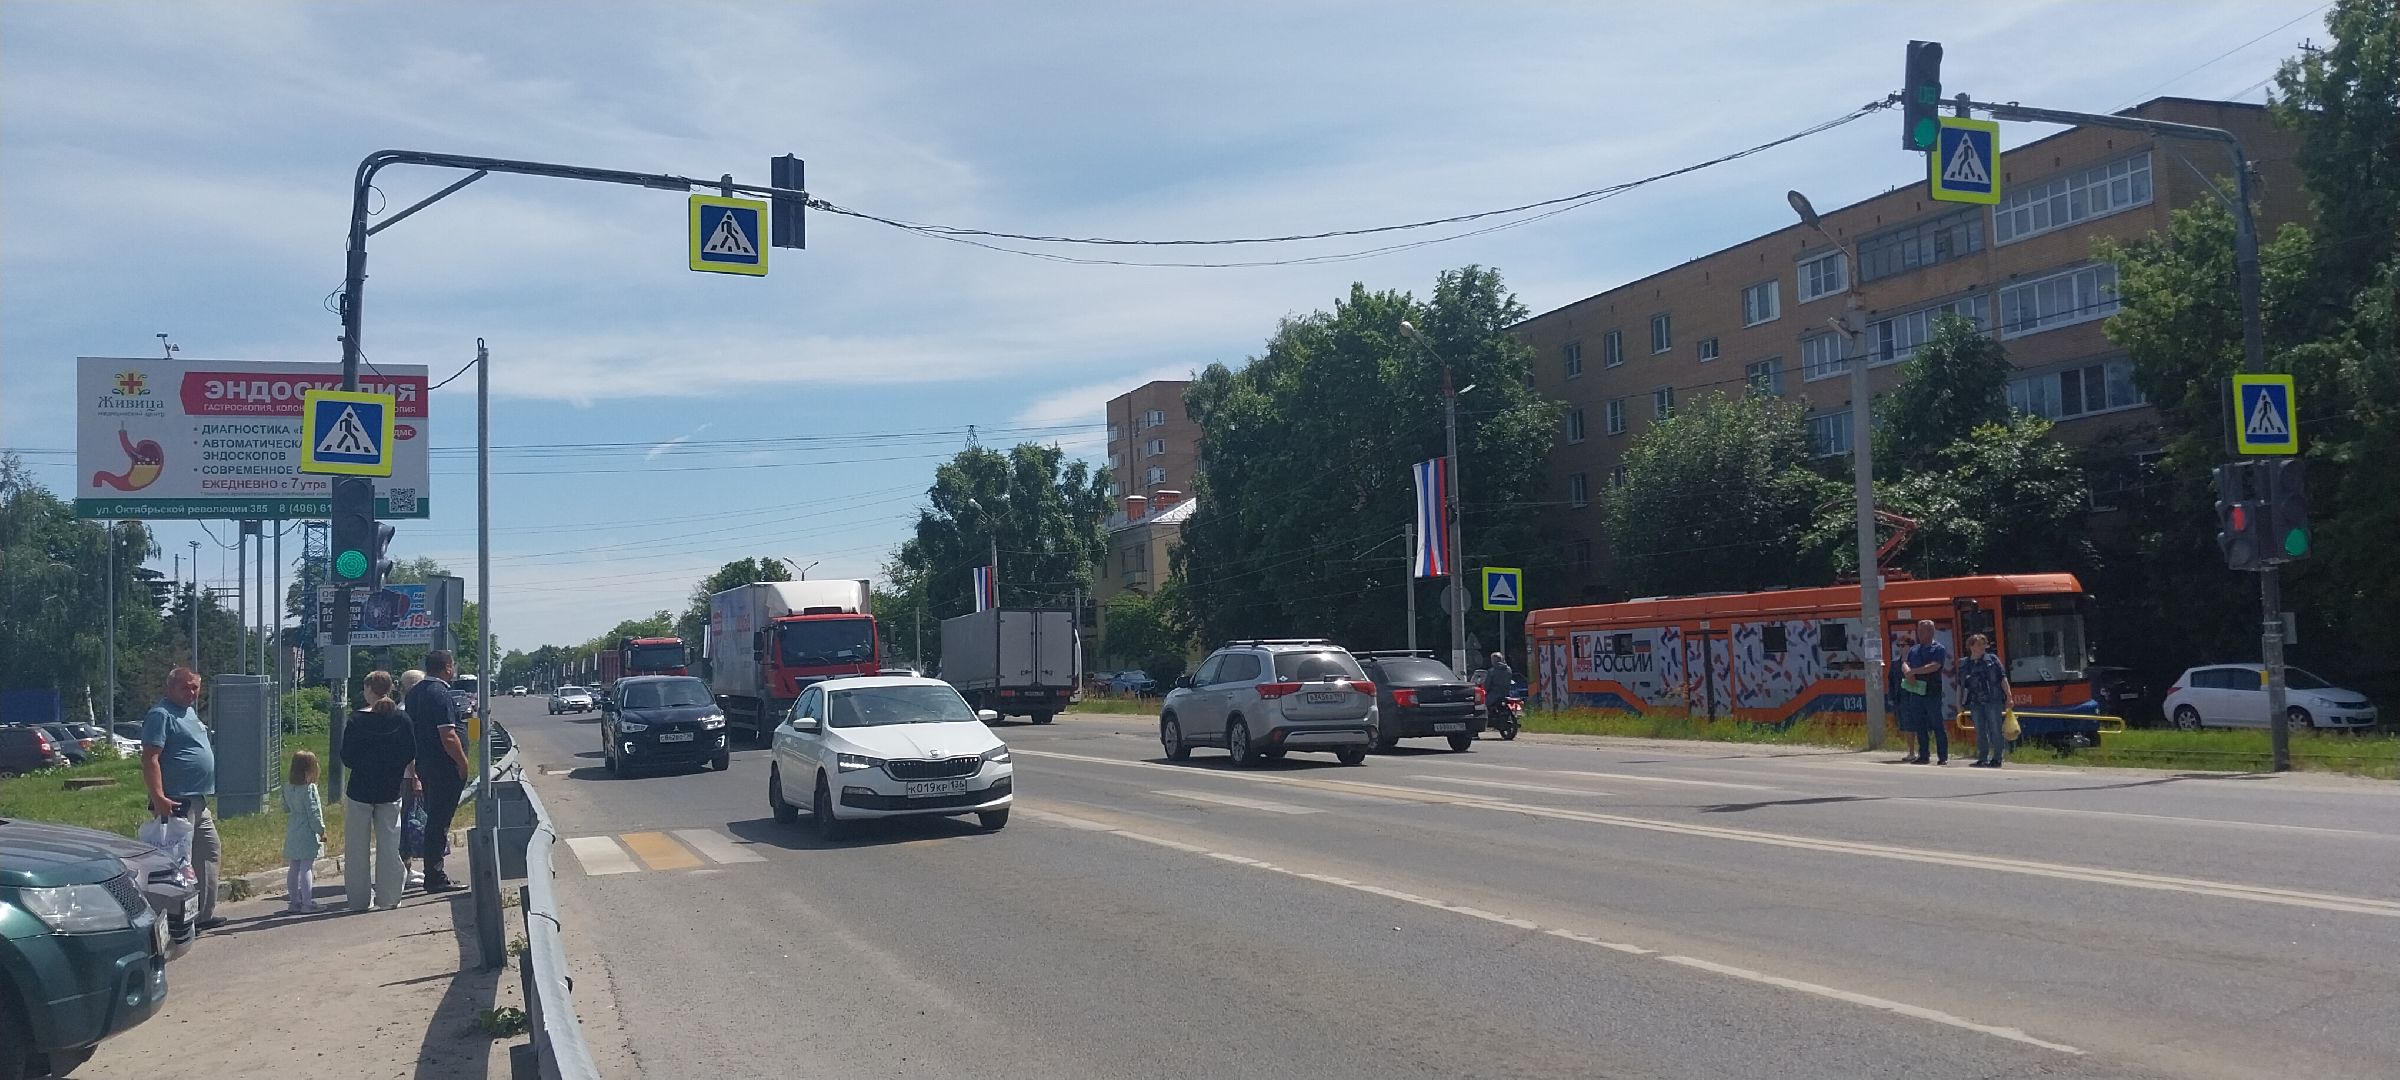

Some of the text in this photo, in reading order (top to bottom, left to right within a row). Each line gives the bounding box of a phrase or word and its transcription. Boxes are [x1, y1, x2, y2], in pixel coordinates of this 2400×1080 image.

[204, 380, 416, 402] ЭНДОСПИЯ
[98, 396, 164, 411] Живица
[203, 403, 274, 413] ГАСТРОСКОПИЯ,
[202, 424, 290, 435] ДИАГНОСТИКА
[203, 451, 286, 461] ЭНДОСКОПОВ
[202, 465, 293, 475] СОВРЕМЕННОЕ
[202, 477, 327, 491] ЕЖЕДНЕВНО с 7 утра
[96, 507, 112, 515] ул.
[115, 504, 184, 515] Октябрьской
[187, 506, 248, 515] революции
[250, 504, 268, 514] 385
[279, 504, 286, 513] 8
[289, 504, 317, 515] (496)
[1594, 653, 1653, 673] РОССИИ
[1843, 696, 1863, 710] 034
